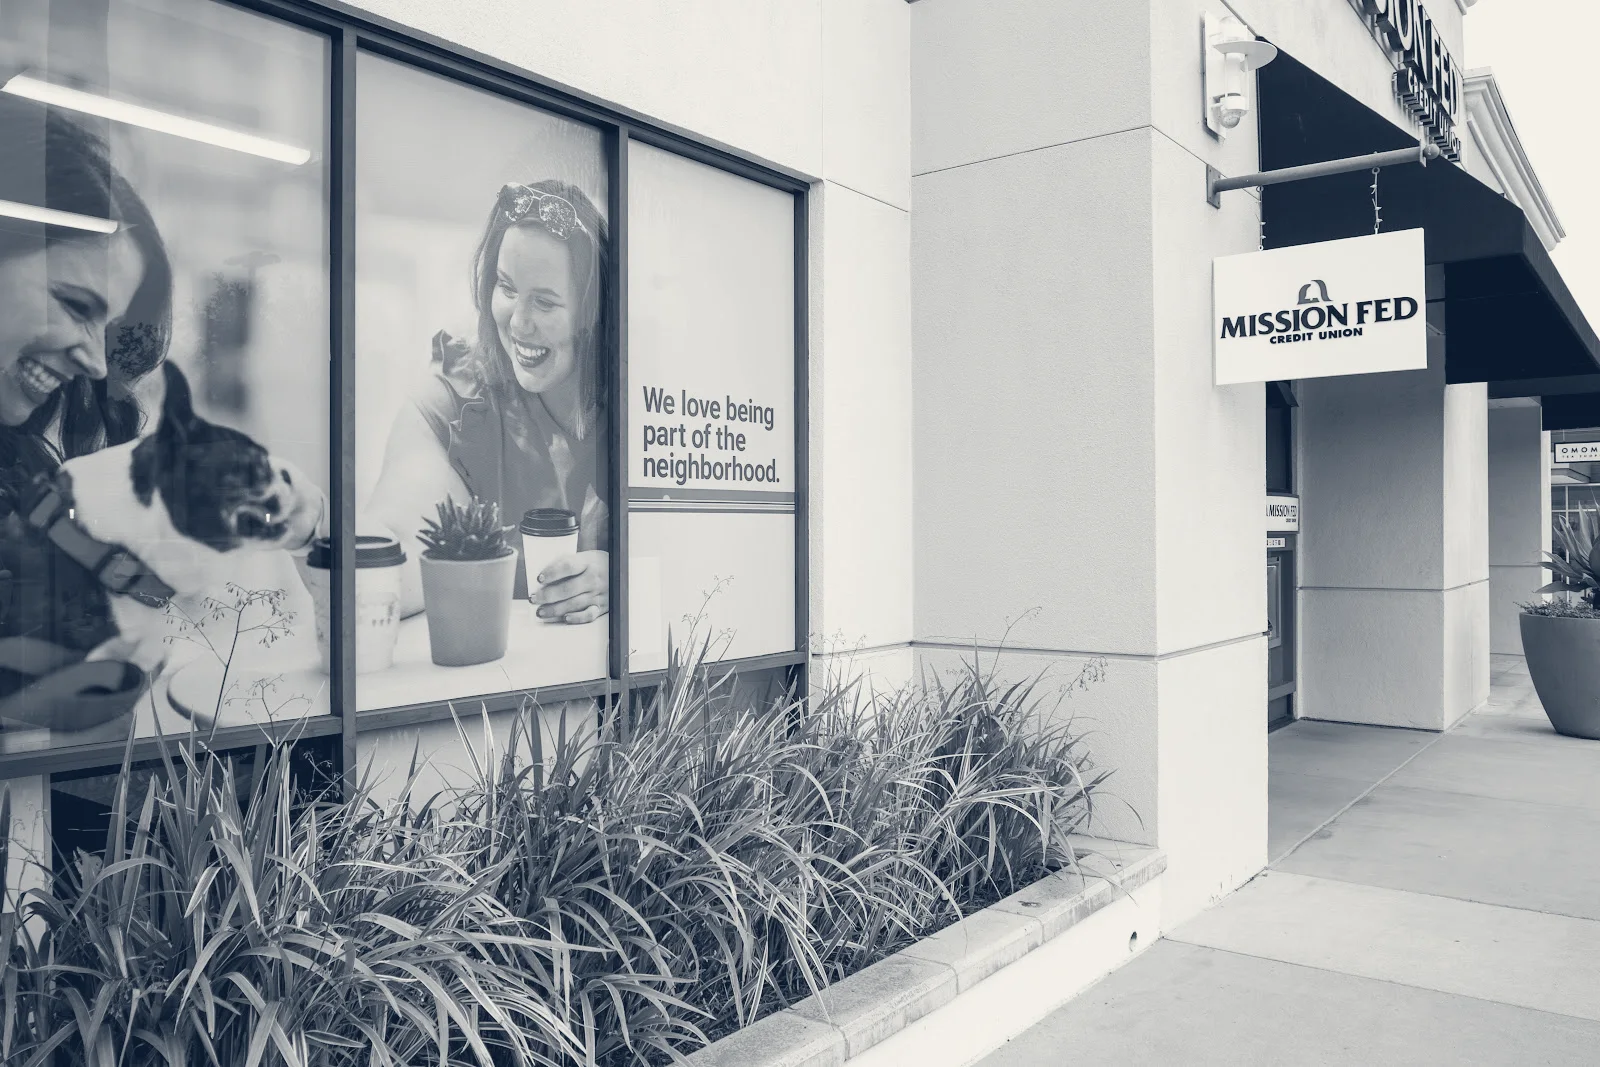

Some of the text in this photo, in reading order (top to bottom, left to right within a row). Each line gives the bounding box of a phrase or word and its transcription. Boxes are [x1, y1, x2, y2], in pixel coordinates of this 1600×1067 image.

[1220, 296, 1419, 339] MISSION FED
[1269, 327, 1363, 345] CREDIT UNION
[643, 385, 774, 432] We love being
[643, 423, 746, 452] part of the
[643, 452, 780, 486] neighborhood.
[1269, 504, 1290, 517] MISSION
